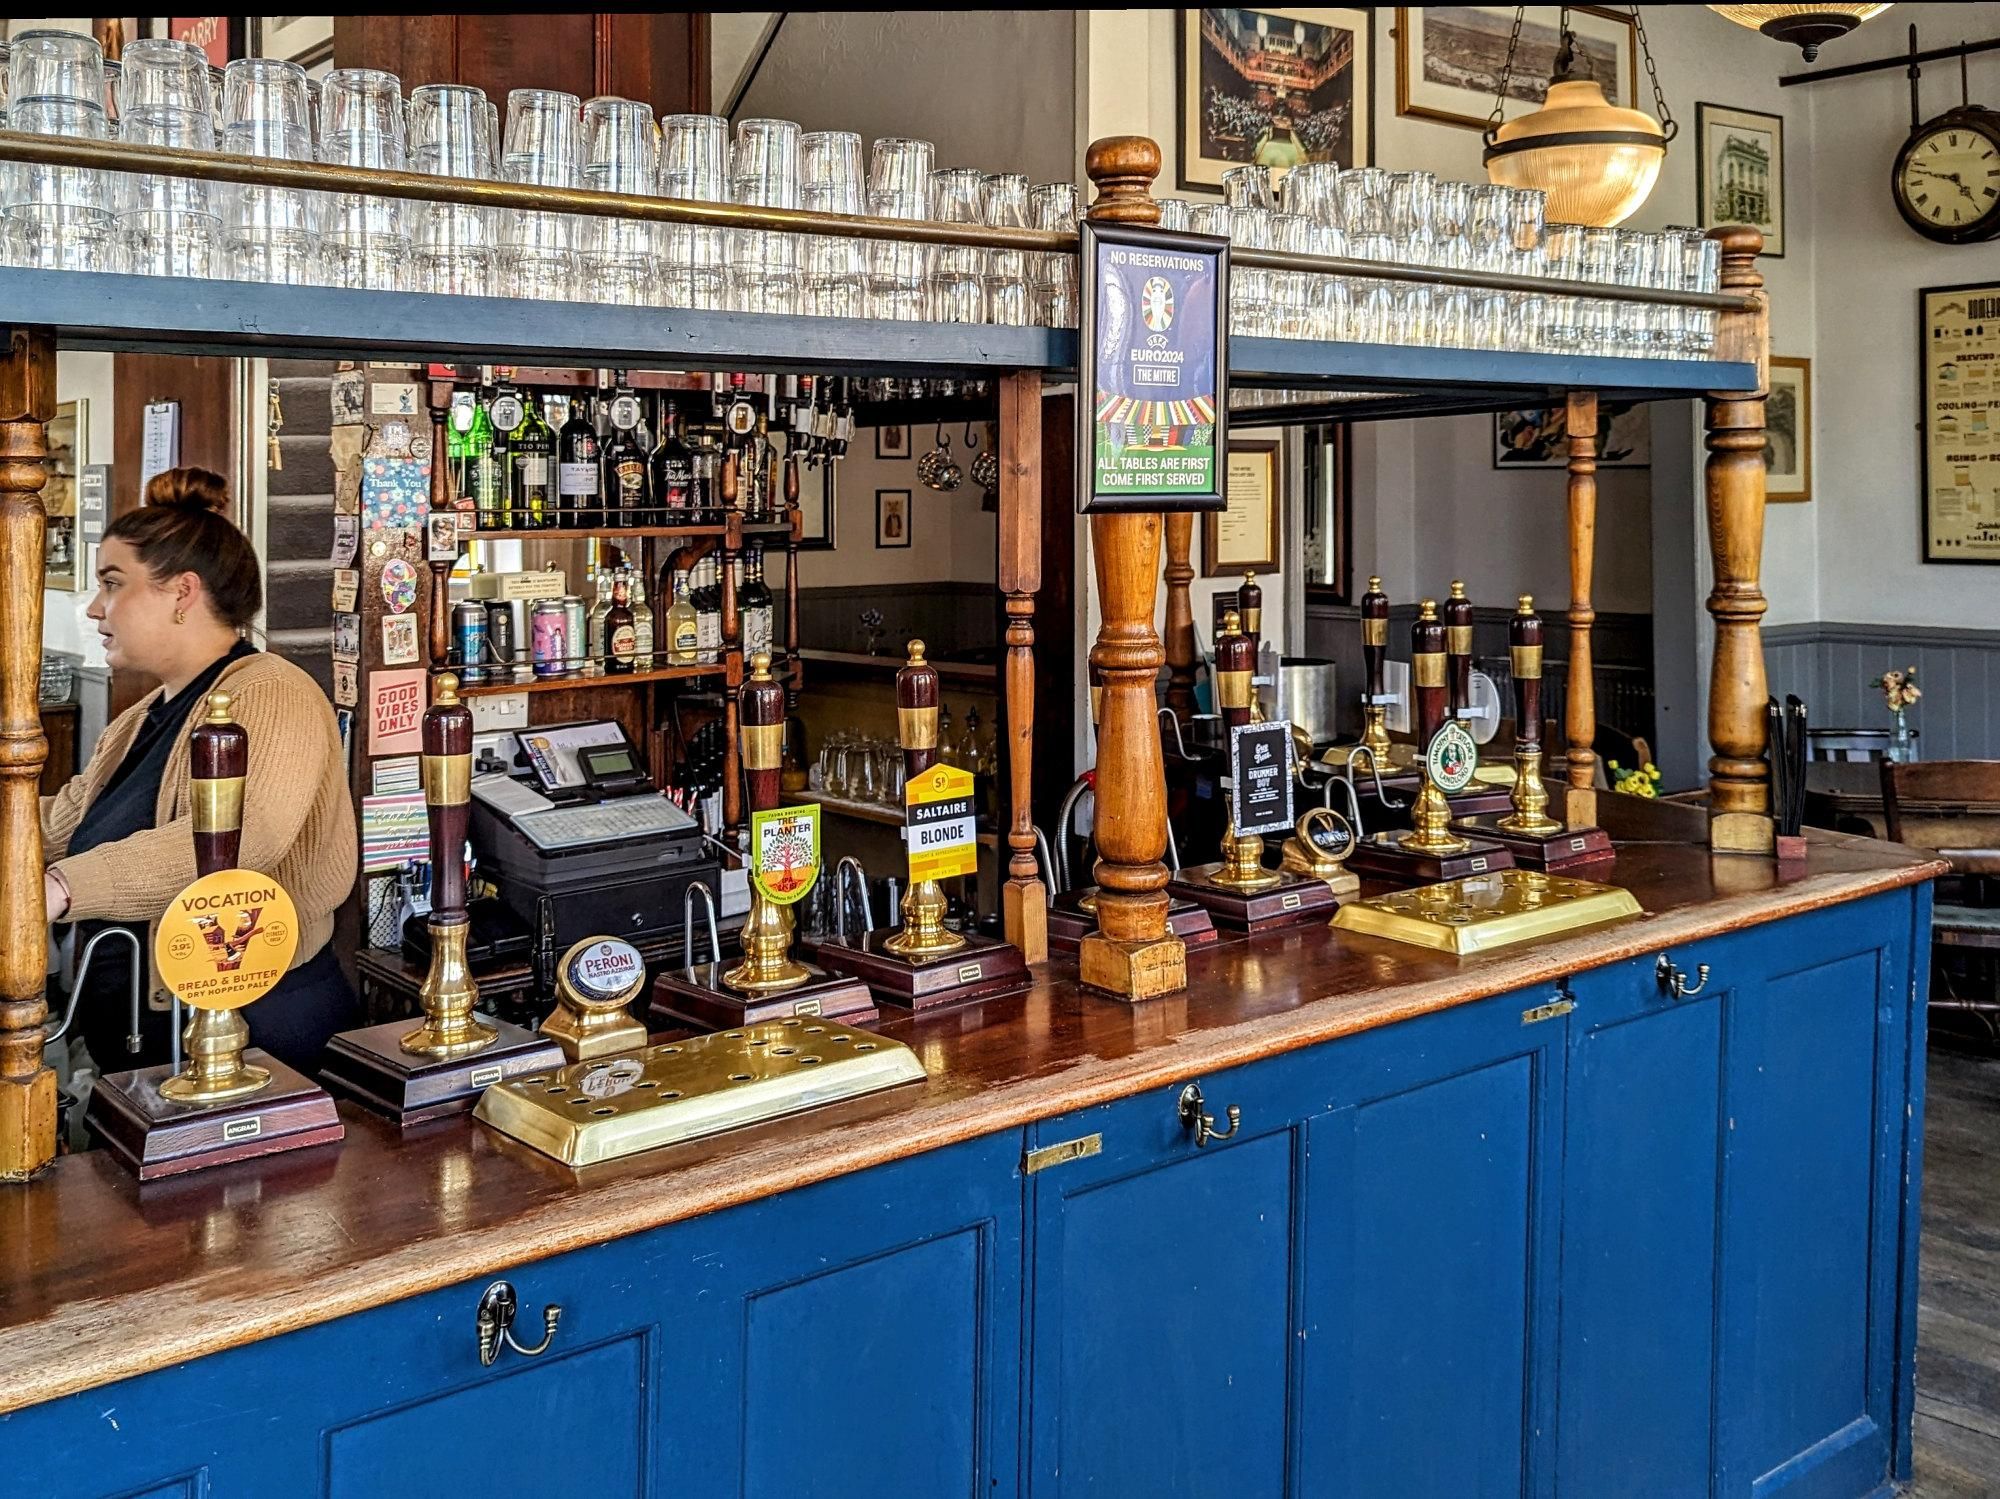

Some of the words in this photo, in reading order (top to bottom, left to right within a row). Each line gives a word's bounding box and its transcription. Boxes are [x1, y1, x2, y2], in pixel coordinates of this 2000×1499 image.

[181, 17, 219, 47] CARRY
[1110, 251, 1127, 264] NO
[1129, 253, 1204, 271] RESERVATIONS
[1130, 349, 1184, 363] EURO2024
[1137, 368, 1152, 381] THE
[1153, 369, 1176, 383] MITRE
[1937, 401, 1977, 410] COOLING
[1097, 458, 1118, 469] ALL
[1120, 458, 1158, 470] TABLES
[1160, 458, 1181, 469] ARE
[1182, 457, 1210, 469] FIRST
[370, 479, 398, 488] Thank
[404, 479, 421, 488] You
[1103, 473, 1133, 486] COME
[1135, 473, 1164, 485] FIRST
[1166, 473, 1205, 485] SERVED
[378, 686, 418, 705] GOOD
[376, 700, 418, 719] VIBES
[378, 713, 415, 732] ONLY
[1248, 767, 1278, 780] DRUMMER
[1439, 767, 1469, 784] LANDLORD
[1256, 777, 1270, 788] BOY
[916, 802, 967, 820] SALTAIRE
[777, 816, 798, 825] TREE
[763, 824, 811, 838] PLANTER
[921, 825, 964, 845] BLONDE
[181, 888, 276, 912] VOCATION
[585, 953, 634, 973] PERONI
[588, 969, 611, 979] NASTRO
[611, 965, 635, 975] AZZURRO
[178, 979, 218, 992] BREAD
[221, 976, 229, 985] &
[233, 969, 278, 984] BUTTER
[187, 990, 205, 999] DRY
[208, 985, 244, 996] HOPPED
[247, 980, 269, 990] PALE
[228, 1123, 257, 1134] ANGRAM
